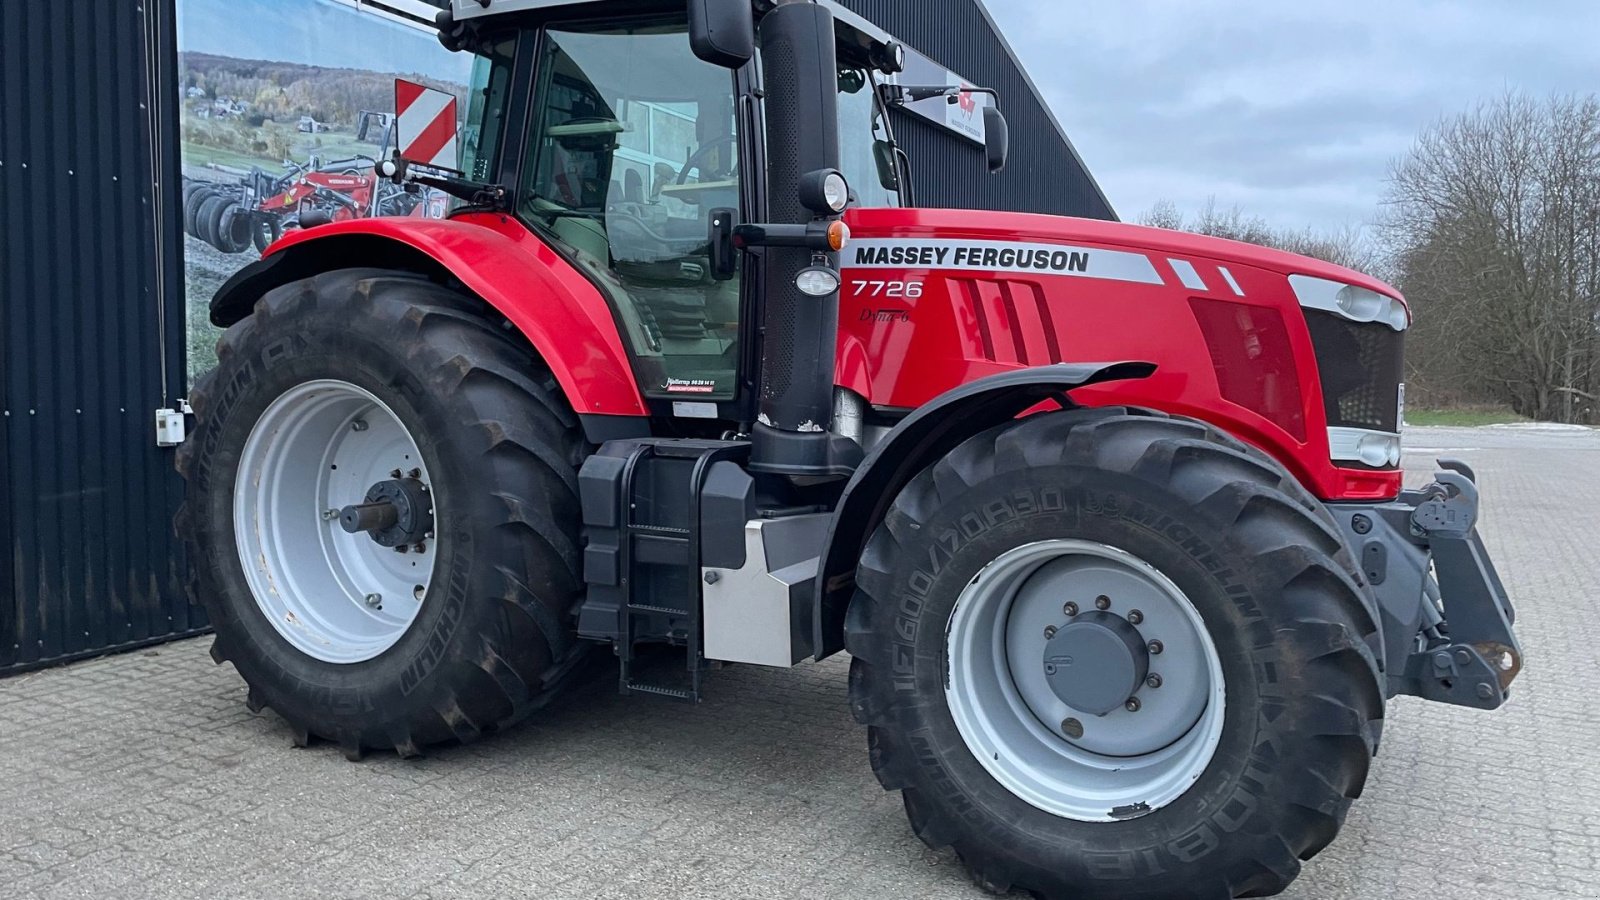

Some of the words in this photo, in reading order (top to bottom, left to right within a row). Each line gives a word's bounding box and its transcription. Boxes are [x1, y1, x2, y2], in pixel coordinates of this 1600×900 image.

[855, 246, 950, 265] MASSEY
[953, 247, 1089, 272] FERGUSON
[851, 280, 924, 298] 7726
[860, 308, 910, 325] Dyna-6
[400, 551, 472, 698] MICHELIN
